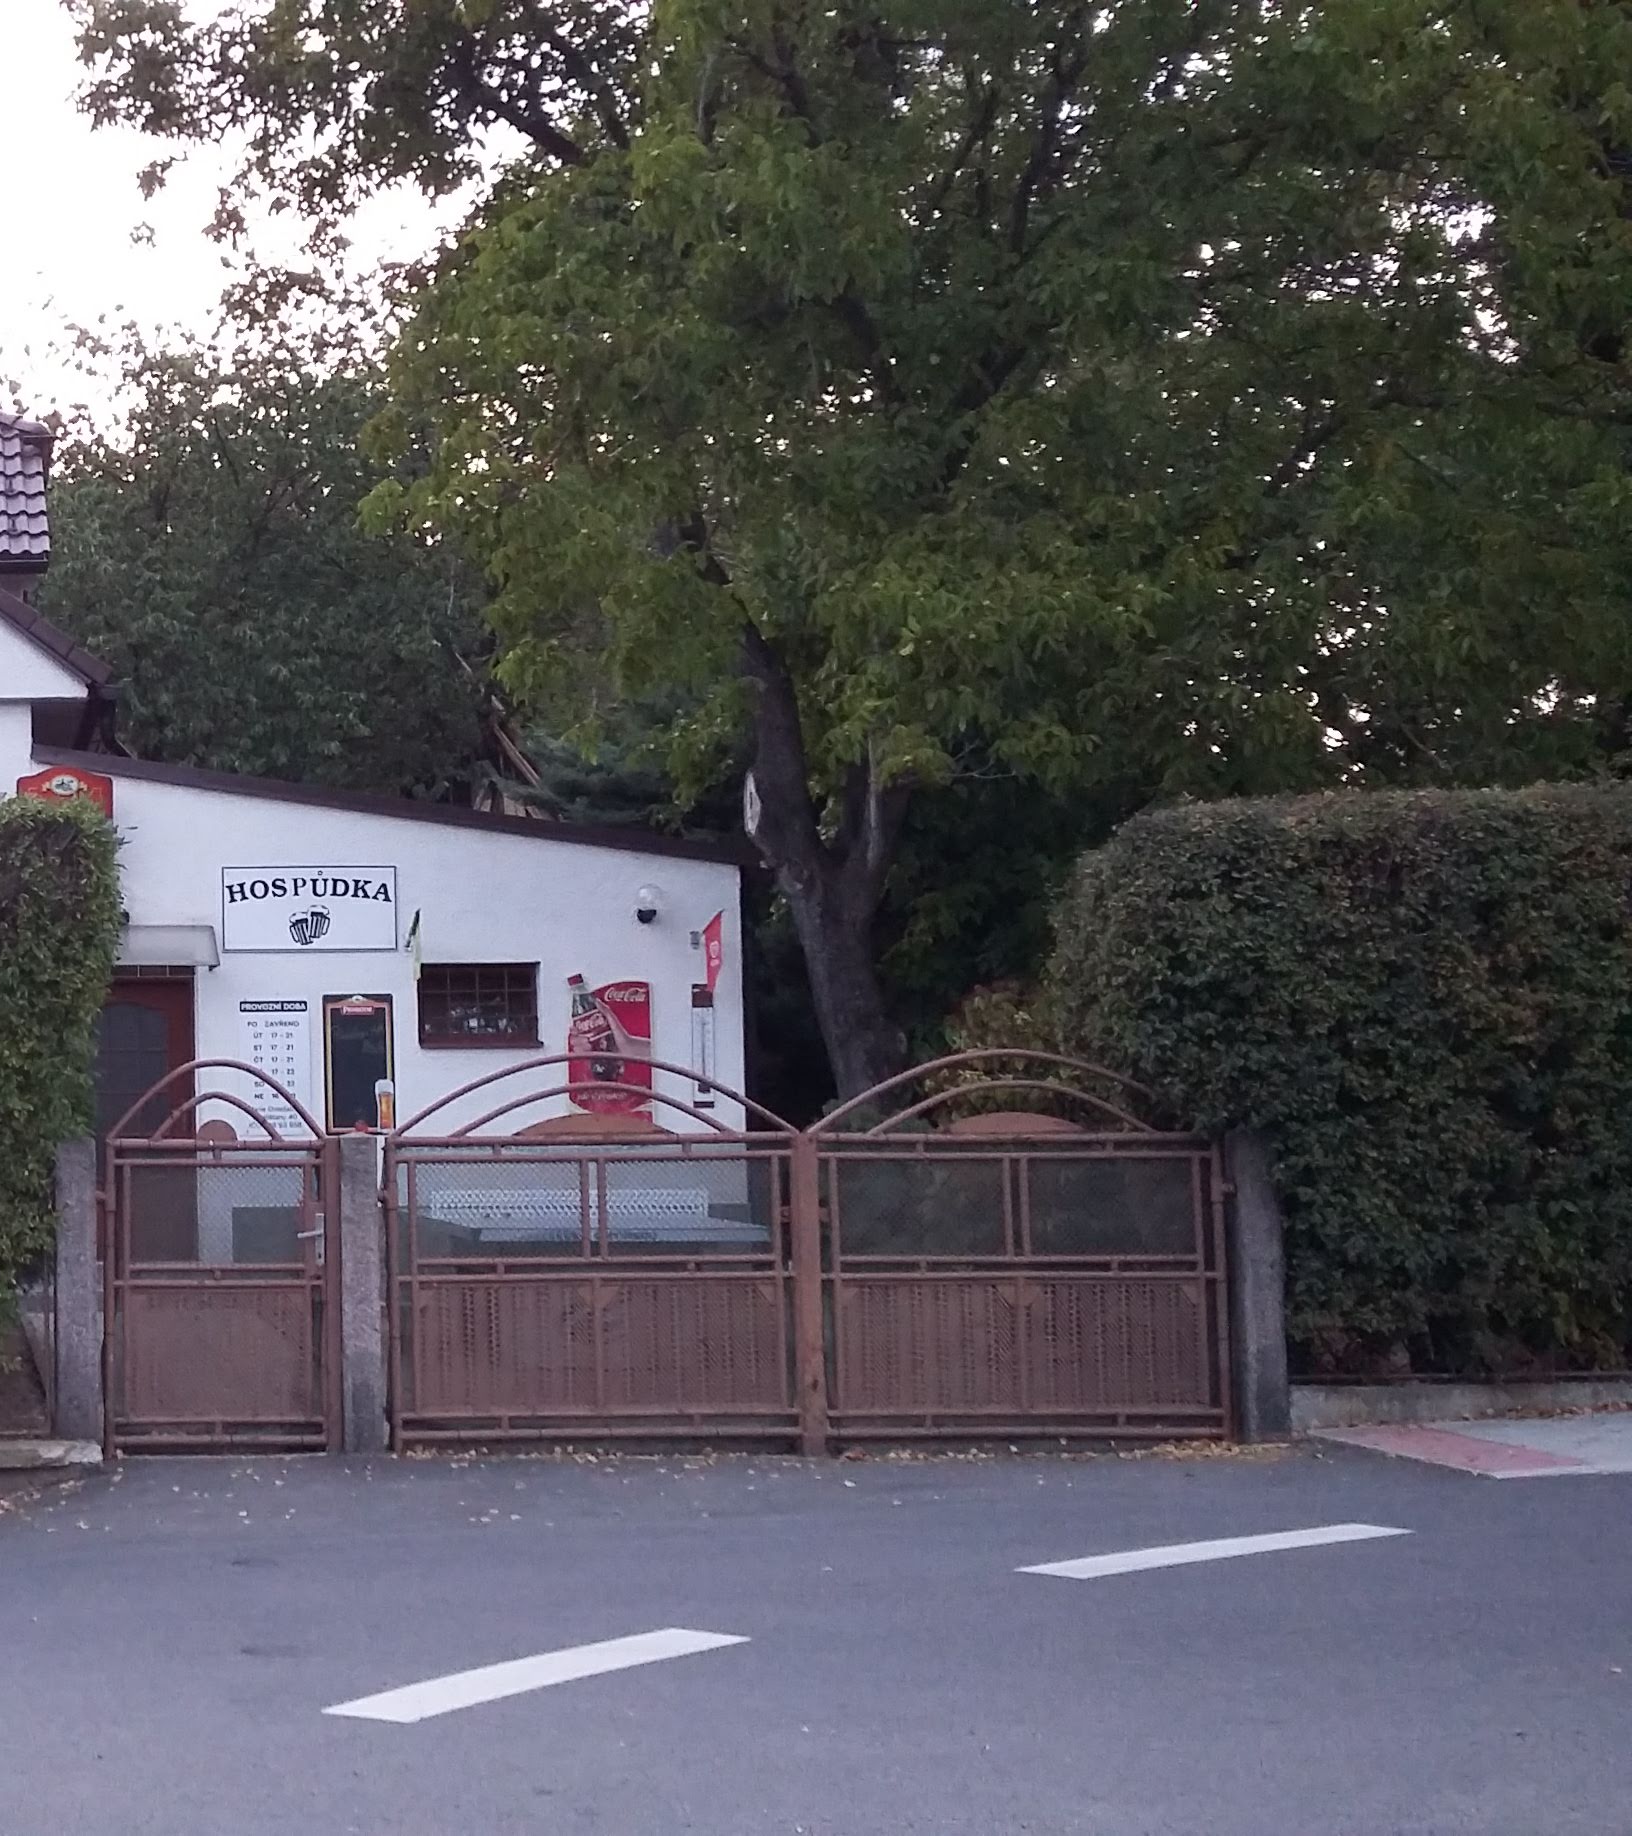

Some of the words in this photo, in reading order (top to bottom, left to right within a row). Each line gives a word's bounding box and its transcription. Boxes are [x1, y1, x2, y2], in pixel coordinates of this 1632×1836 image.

[226, 871, 392, 903] HOSPŮDKA
[240, 1001, 282, 1011] PROVOZNÍ
[283, 1002, 306, 1011] DOBA
[264, 1019, 300, 1028] ZAVŘENO
